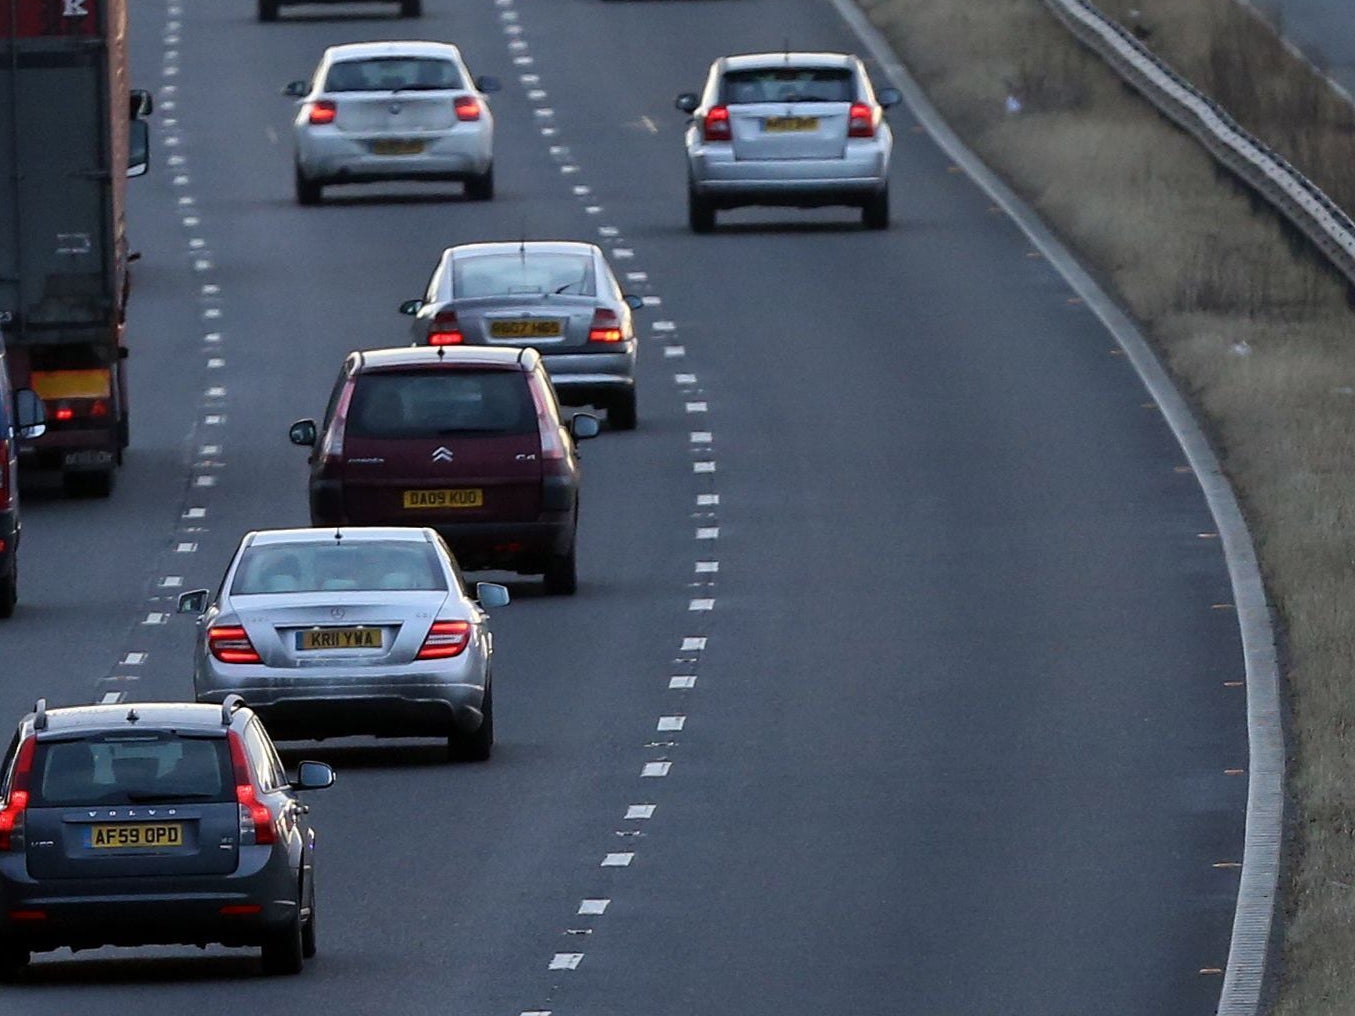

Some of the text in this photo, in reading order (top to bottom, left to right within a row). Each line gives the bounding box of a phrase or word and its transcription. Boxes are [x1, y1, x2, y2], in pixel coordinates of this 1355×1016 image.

[410, 492, 445, 505] DA09
[311, 632, 373, 647] KR11 YWA
[89, 809, 176, 817] VOLVO
[95, 826, 178, 844] AF59 OPD
